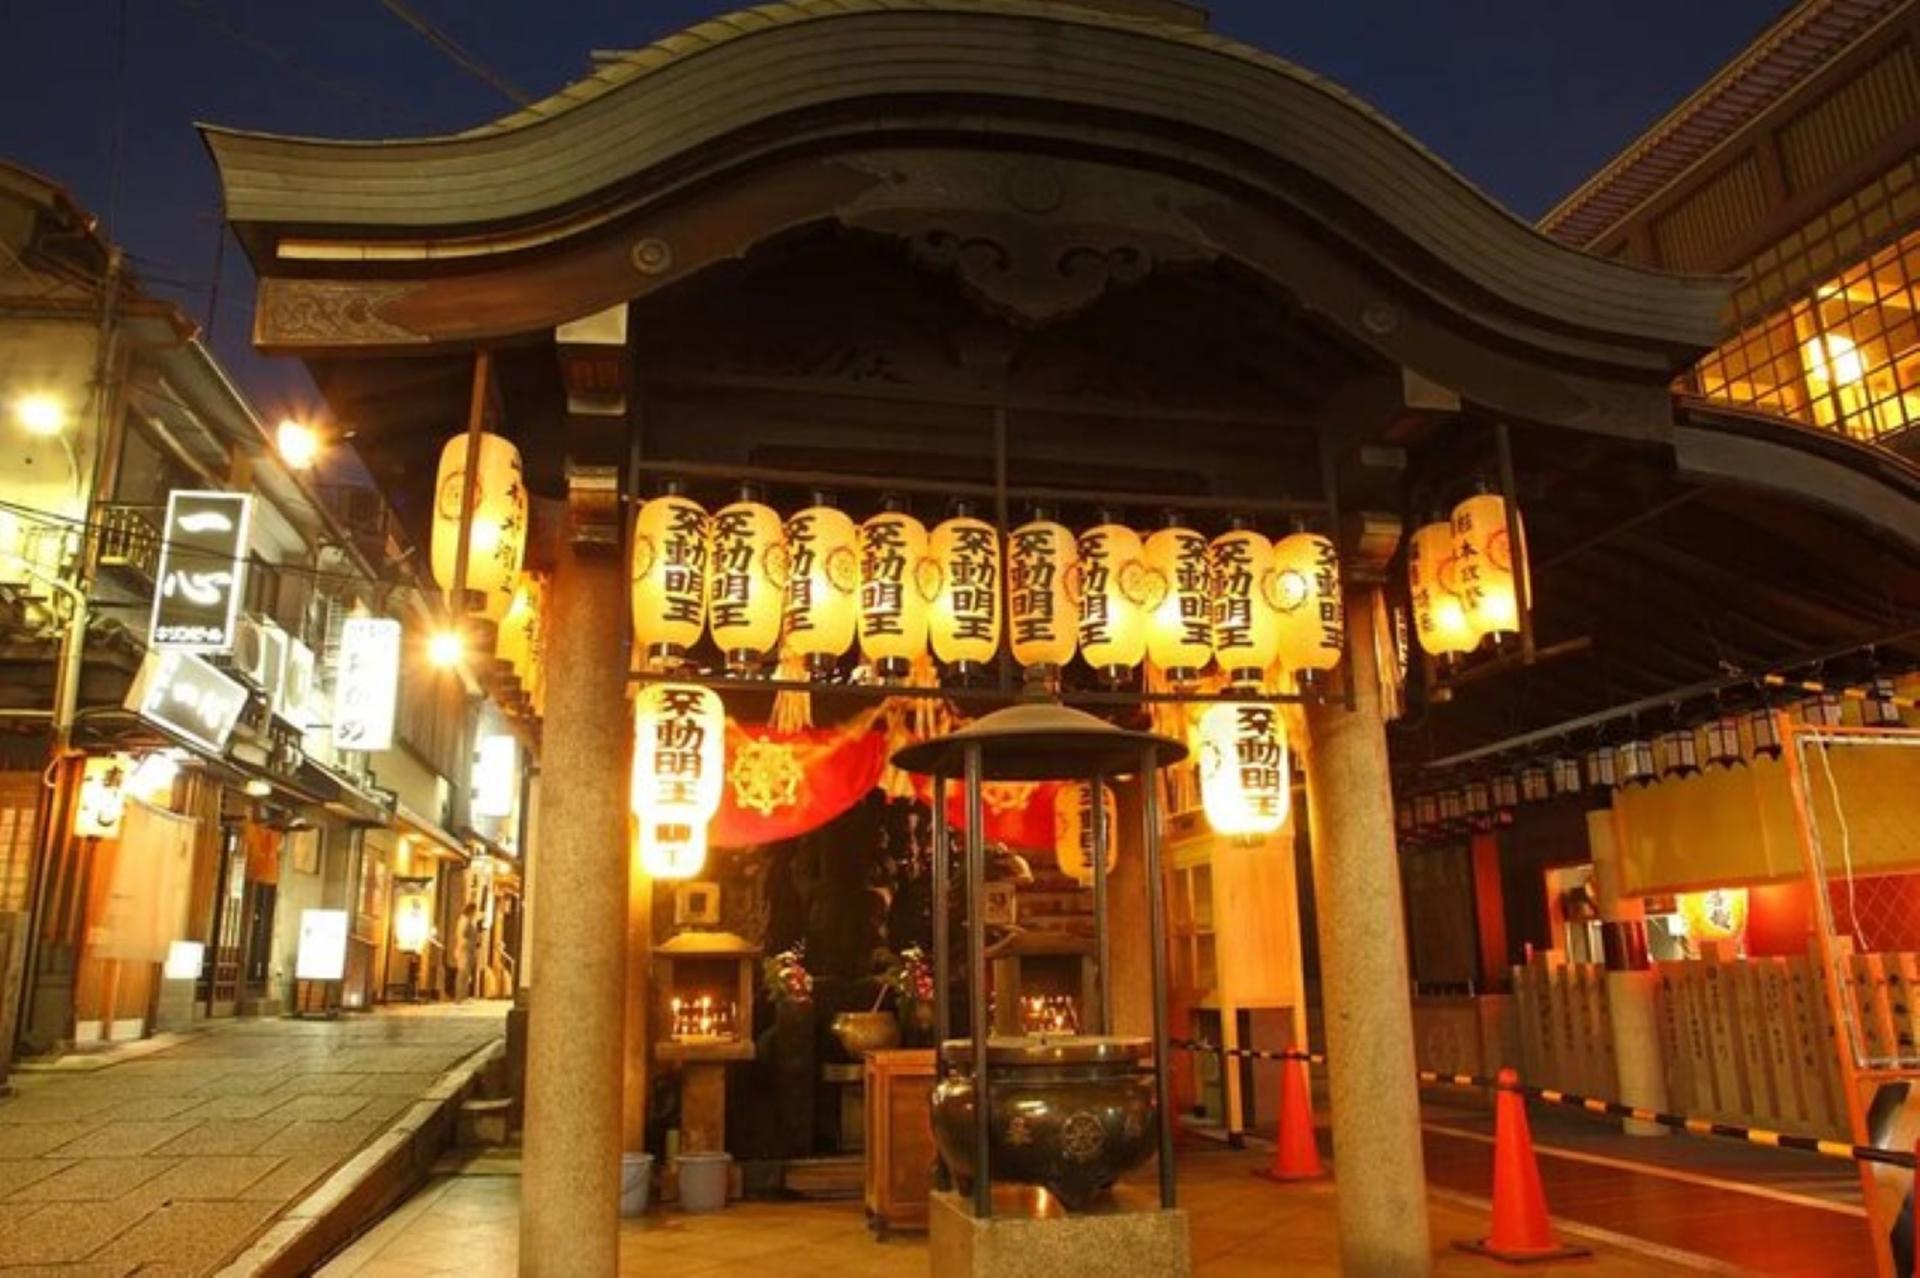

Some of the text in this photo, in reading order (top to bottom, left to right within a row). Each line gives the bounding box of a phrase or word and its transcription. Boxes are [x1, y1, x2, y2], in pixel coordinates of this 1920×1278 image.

[662, 504, 709, 626] 不動明王
[711, 511, 755, 629] 不動明王
[861, 522, 905, 637] 不動明王
[950, 527, 995, 643] 不動明王
[1011, 530, 1056, 645] 不動明王
[656, 690, 706, 805] 不動明王
[1236, 707, 1281, 816] 不動明王
